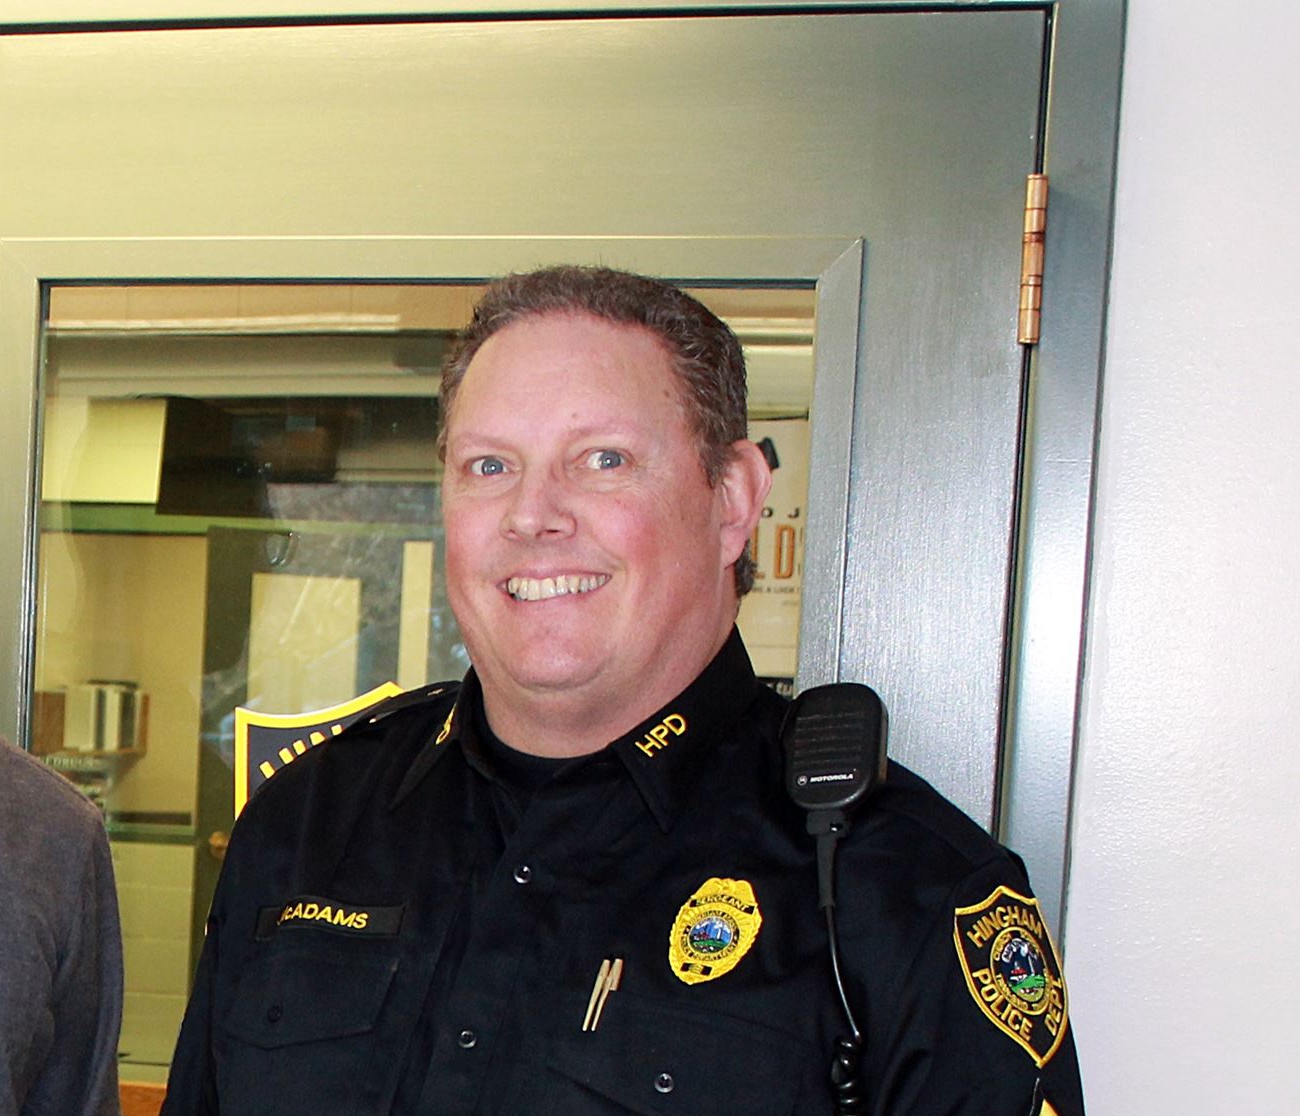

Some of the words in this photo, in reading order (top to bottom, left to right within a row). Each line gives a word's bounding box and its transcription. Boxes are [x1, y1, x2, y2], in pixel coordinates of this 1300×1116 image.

[635, 713, 687, 758] HPD
[810, 773, 854, 783] MOTOROLA
[966, 905, 1043, 948] HINGHAM
[972, 968, 1033, 1041] POLICE
